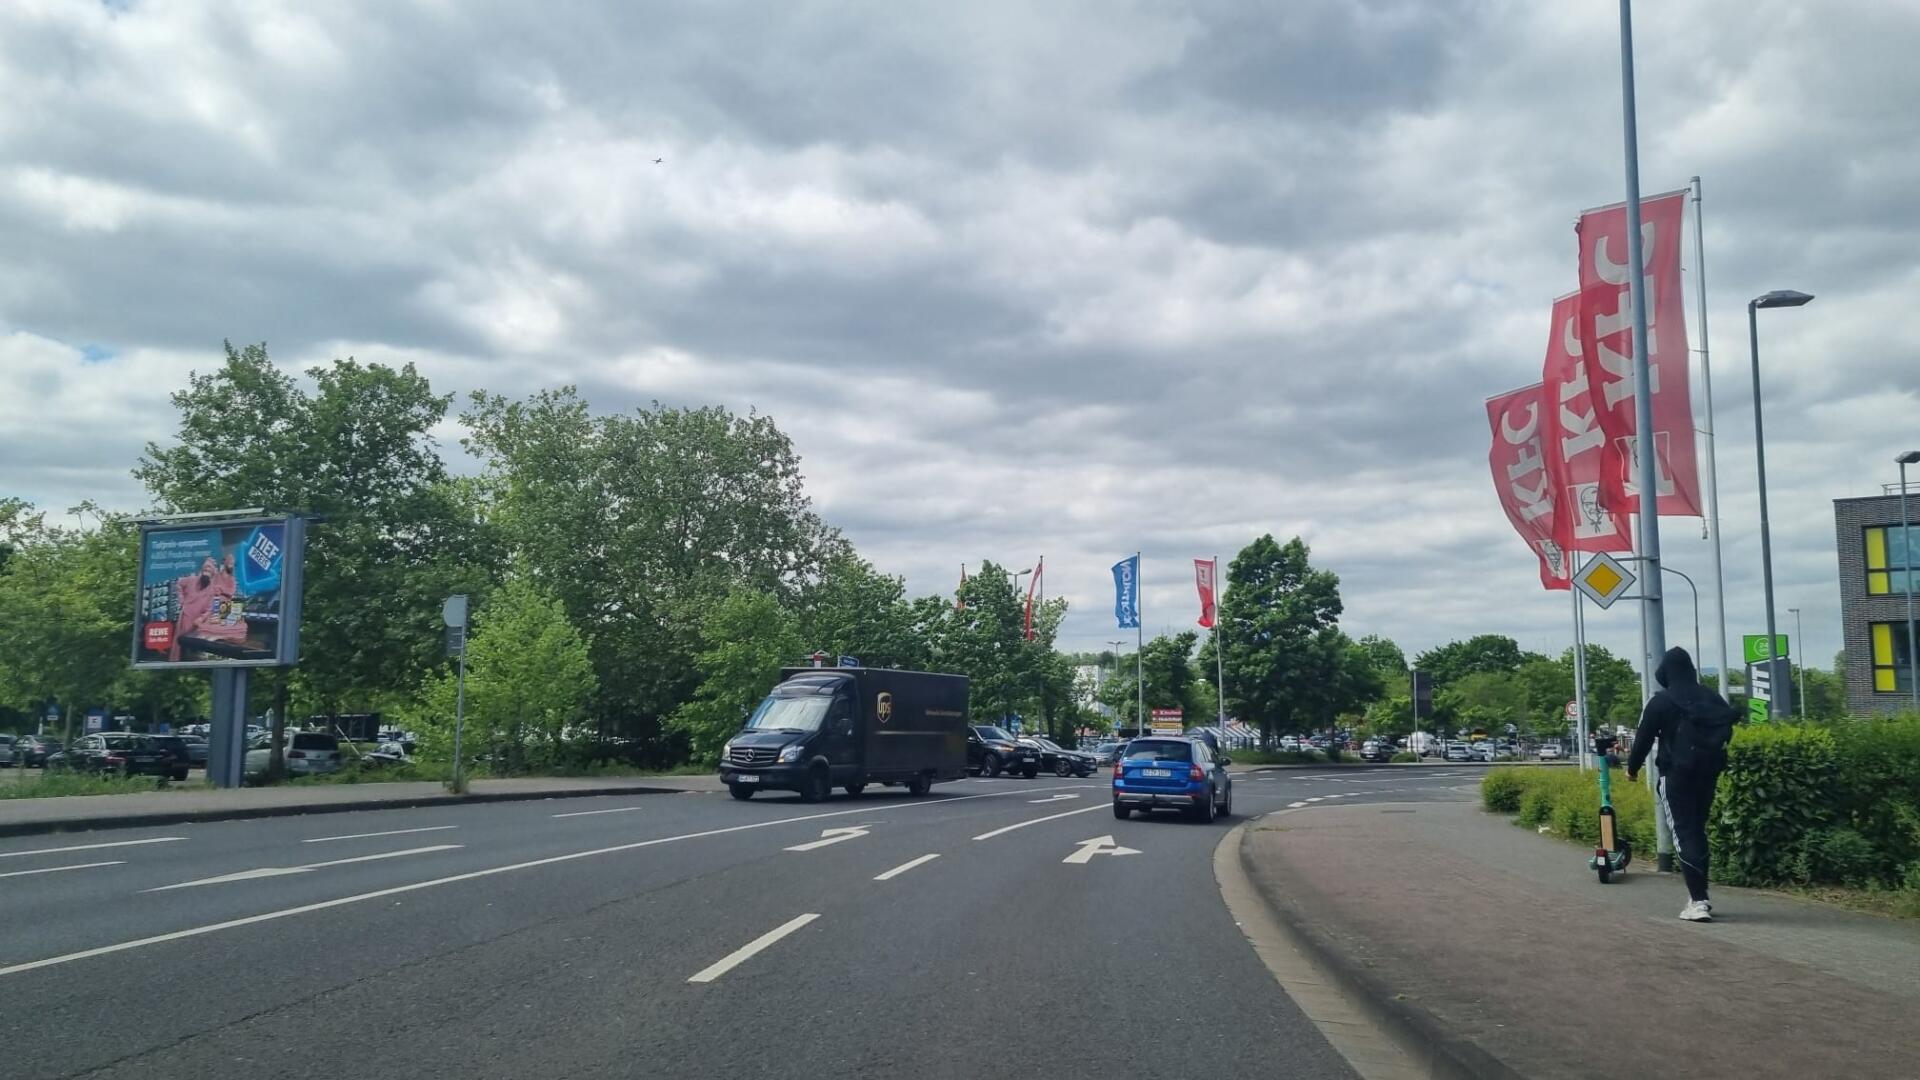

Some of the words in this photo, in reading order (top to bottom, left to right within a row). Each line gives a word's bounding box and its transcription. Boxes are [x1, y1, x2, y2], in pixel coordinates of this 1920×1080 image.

[255, 532, 280, 559] TIEF
[251, 548, 269, 568] PREIS
[149, 627, 169, 636] REWE
[878, 702, 892, 718] ups
[1569, 705, 1577, 713] 30
